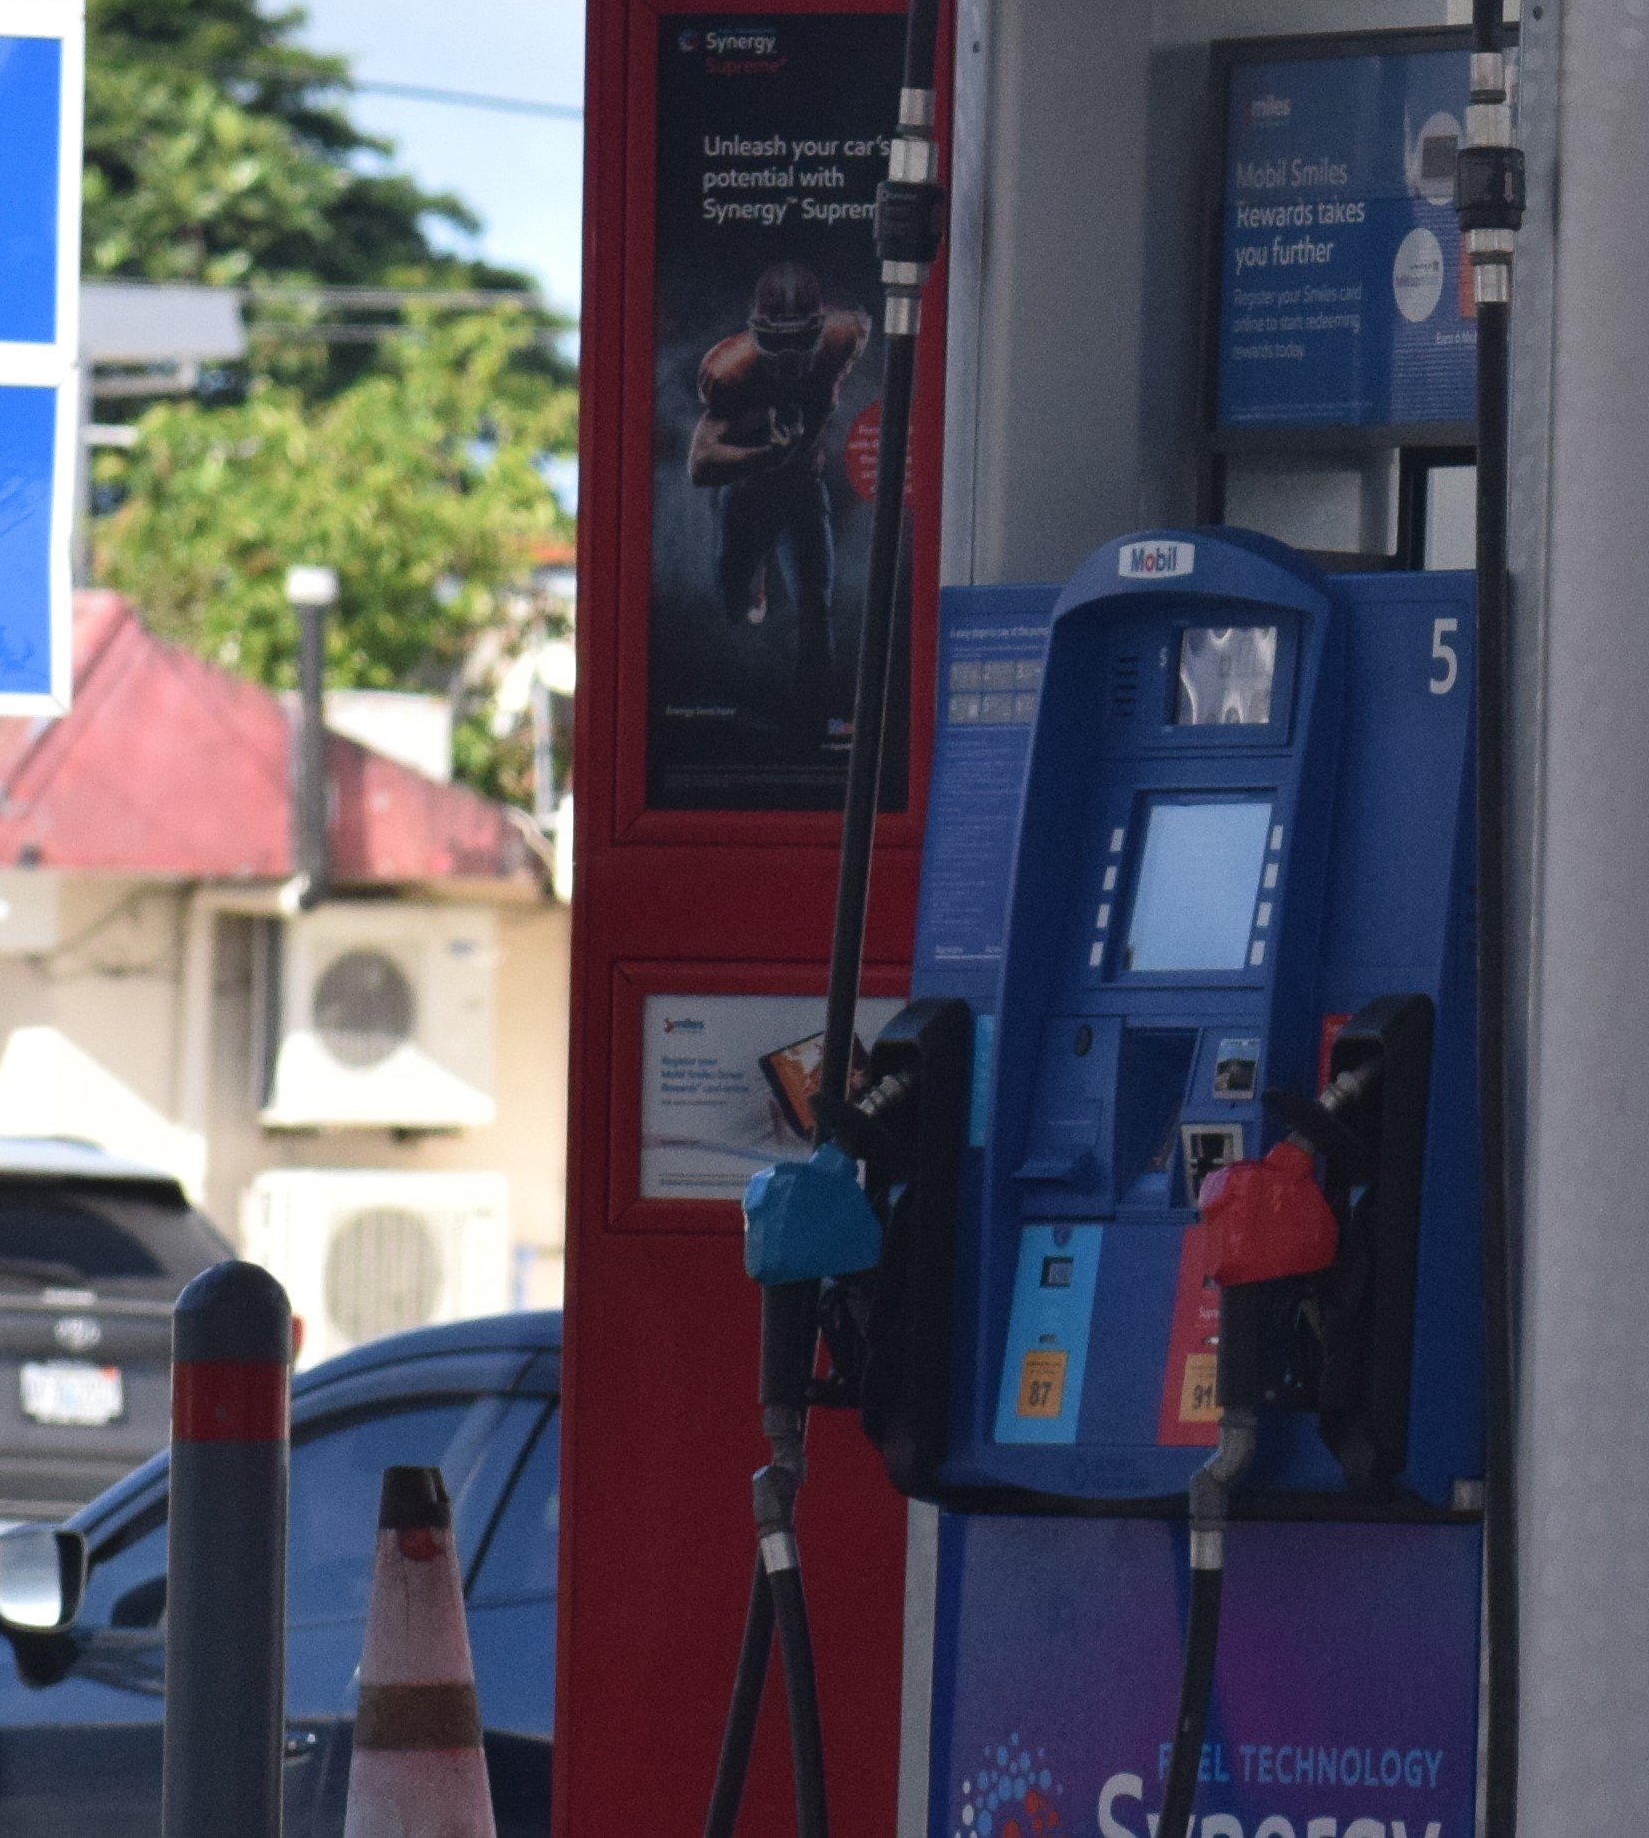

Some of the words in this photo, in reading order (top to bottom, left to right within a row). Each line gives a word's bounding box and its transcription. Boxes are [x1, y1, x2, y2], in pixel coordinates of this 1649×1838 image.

[705, 31, 777, 55] Synergy
[703, 134, 786, 157] Unleash
[792, 138, 837, 162] your
[843, 135, 890, 157] car's
[702, 166, 794, 193] potential
[800, 166, 845, 188] with
[1235, 160, 1287, 188] Mobil
[1291, 157, 1348, 186] Smiles
[1237, 202, 1313, 228] Rewards
[1318, 196, 1365, 224] takes
[1235, 245, 1268, 275] you
[1272, 235, 1334, 265] further
[1131, 545, 1178, 573] Mobil
[1429, 617, 1460, 696] 5
[1028, 1380, 1052, 1408] 87
[1192, 1383, 1214, 1410] 91
[1157, 1740, 1231, 1784] FEL
[1238, 1744, 1444, 1789] TECHNOLOGY
